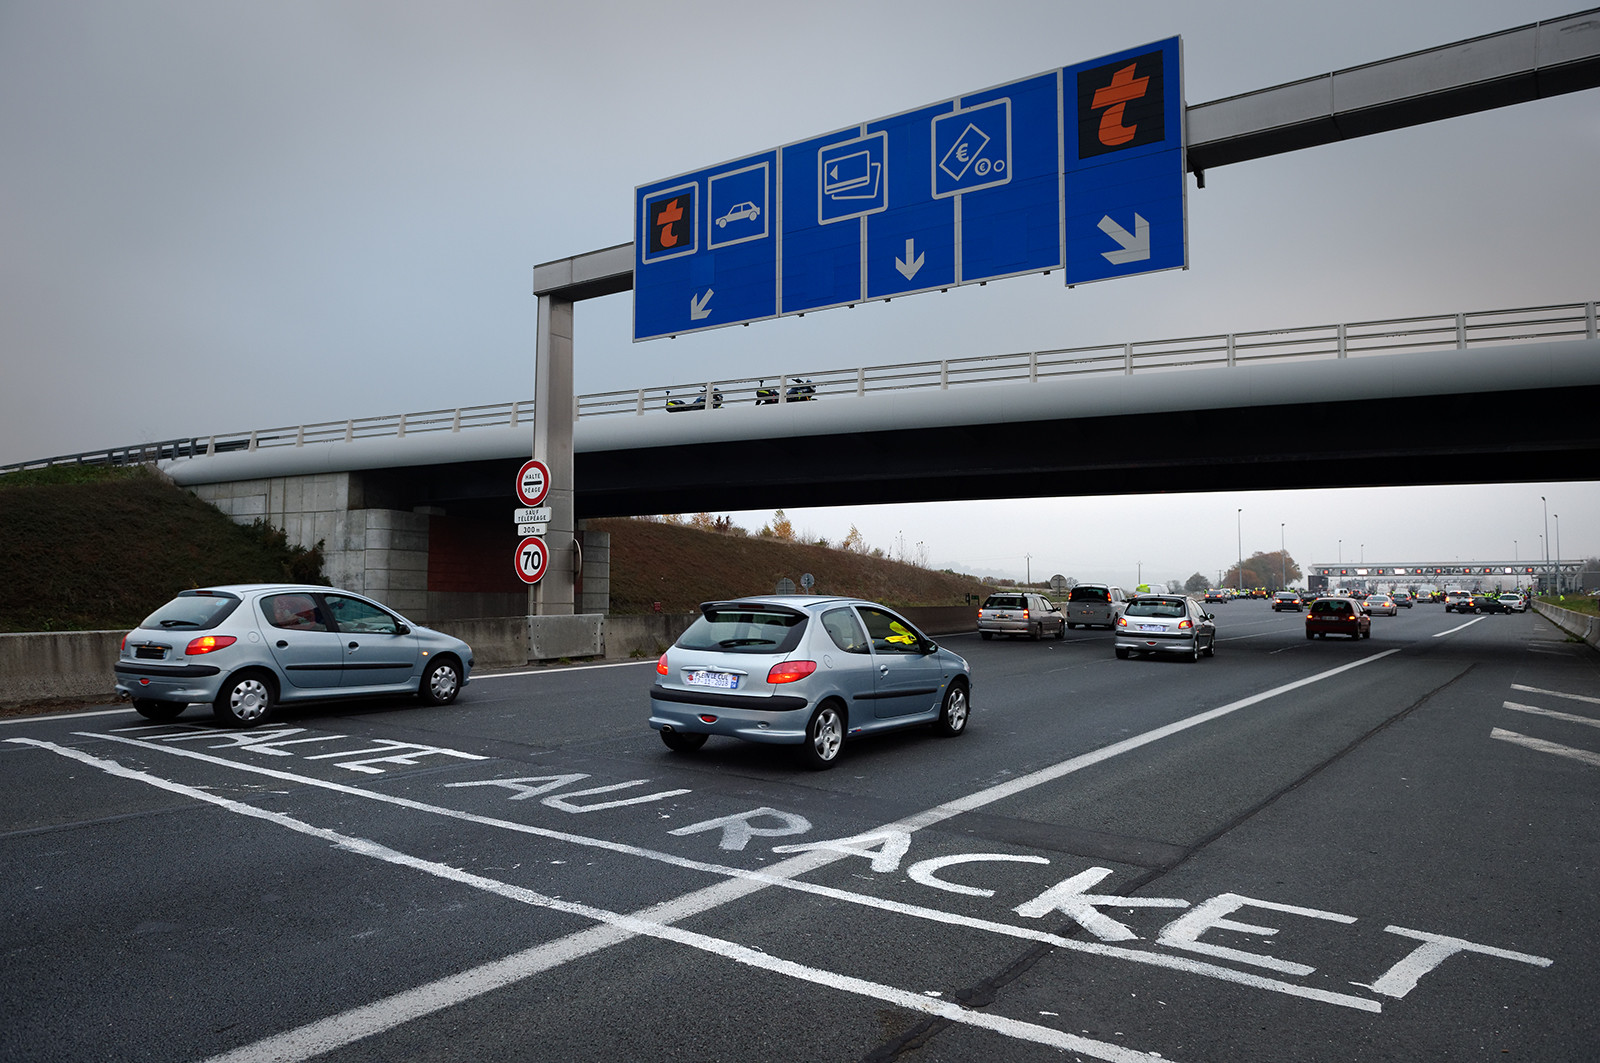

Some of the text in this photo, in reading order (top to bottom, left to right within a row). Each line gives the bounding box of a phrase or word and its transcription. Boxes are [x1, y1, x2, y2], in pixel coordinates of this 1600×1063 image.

[522, 551, 542, 570] 70
[108, 721, 1555, 998] HALTE AU RACKET
